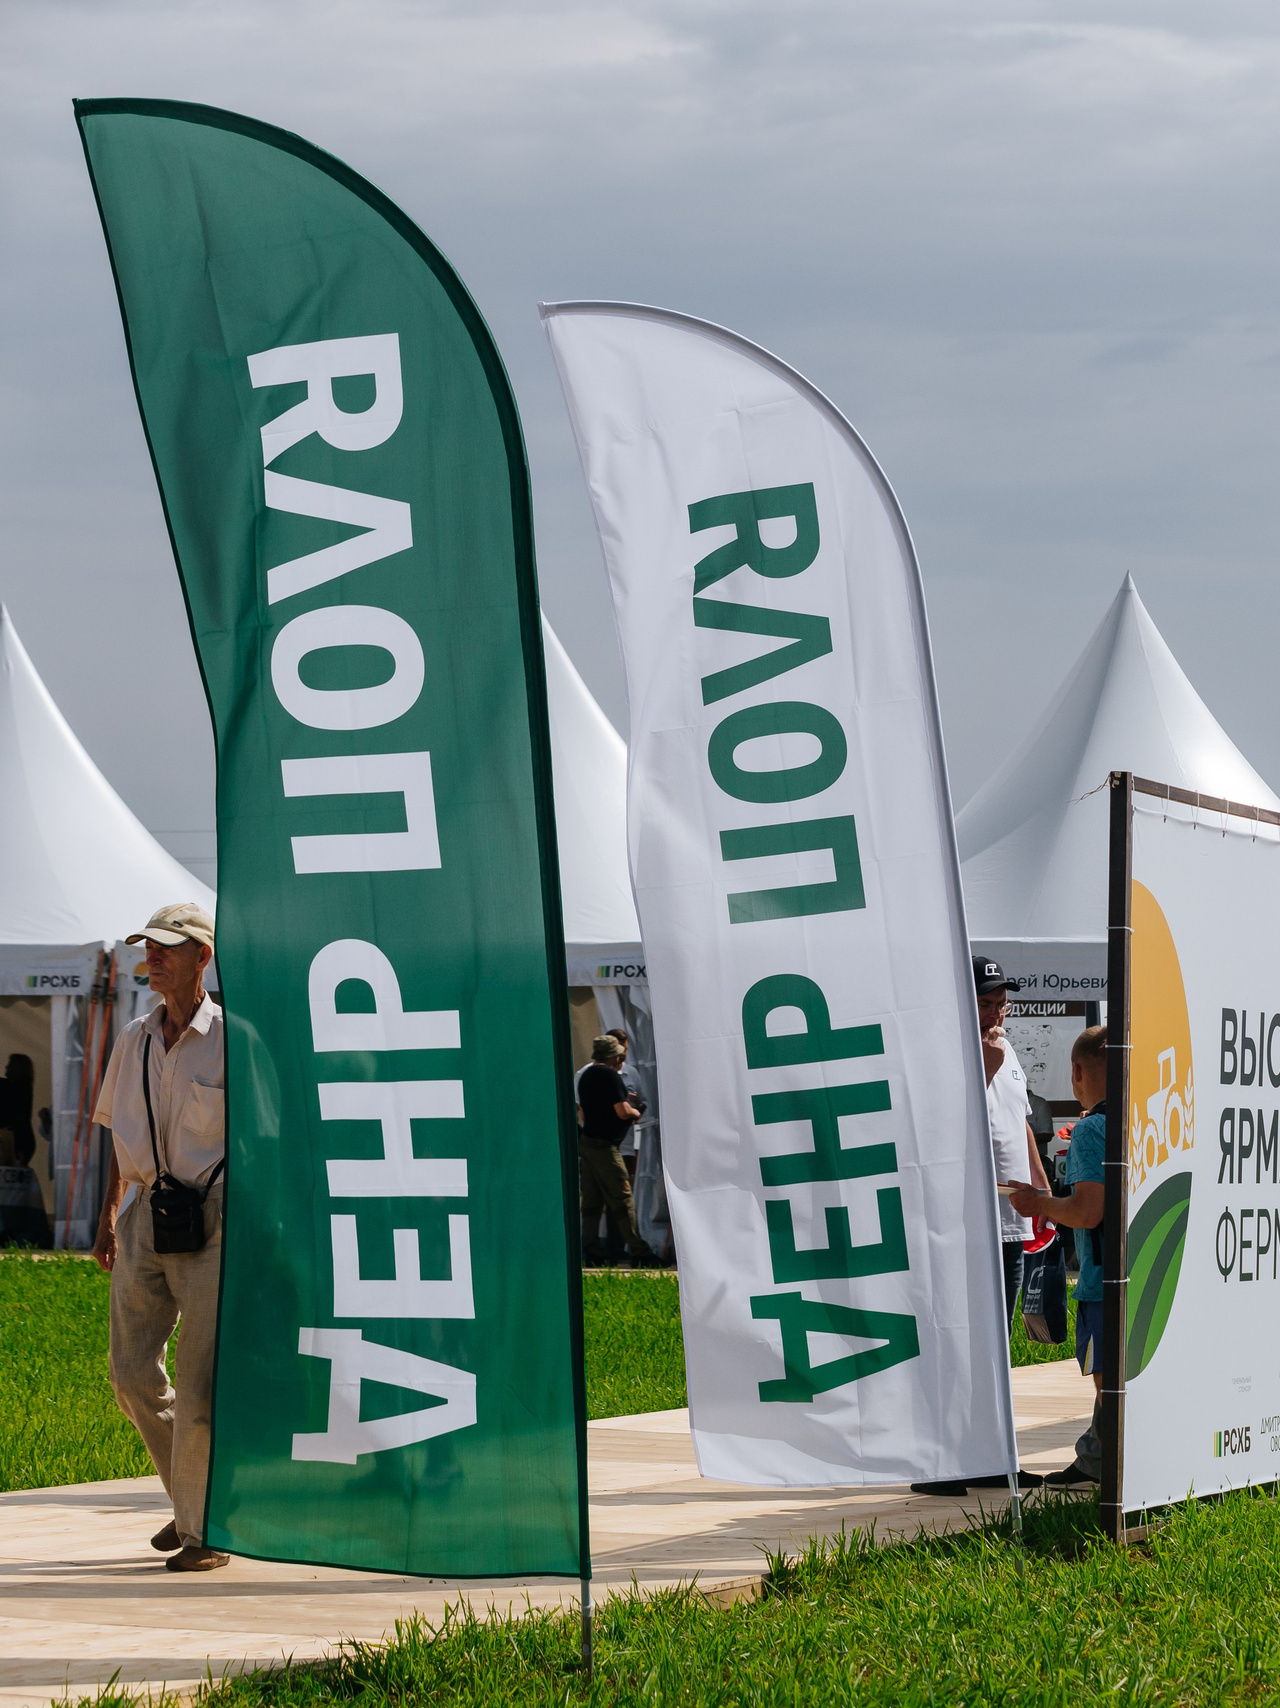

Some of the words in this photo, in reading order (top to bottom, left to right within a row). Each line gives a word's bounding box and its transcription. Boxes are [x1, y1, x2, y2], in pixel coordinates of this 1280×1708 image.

[613, 964, 647, 978] РСХ
[40, 975, 81, 988] РСХБ
[1009, 1003, 1066, 1017] ДУКЦИИ
[1223, 1425, 1251, 1457] РСХБ
